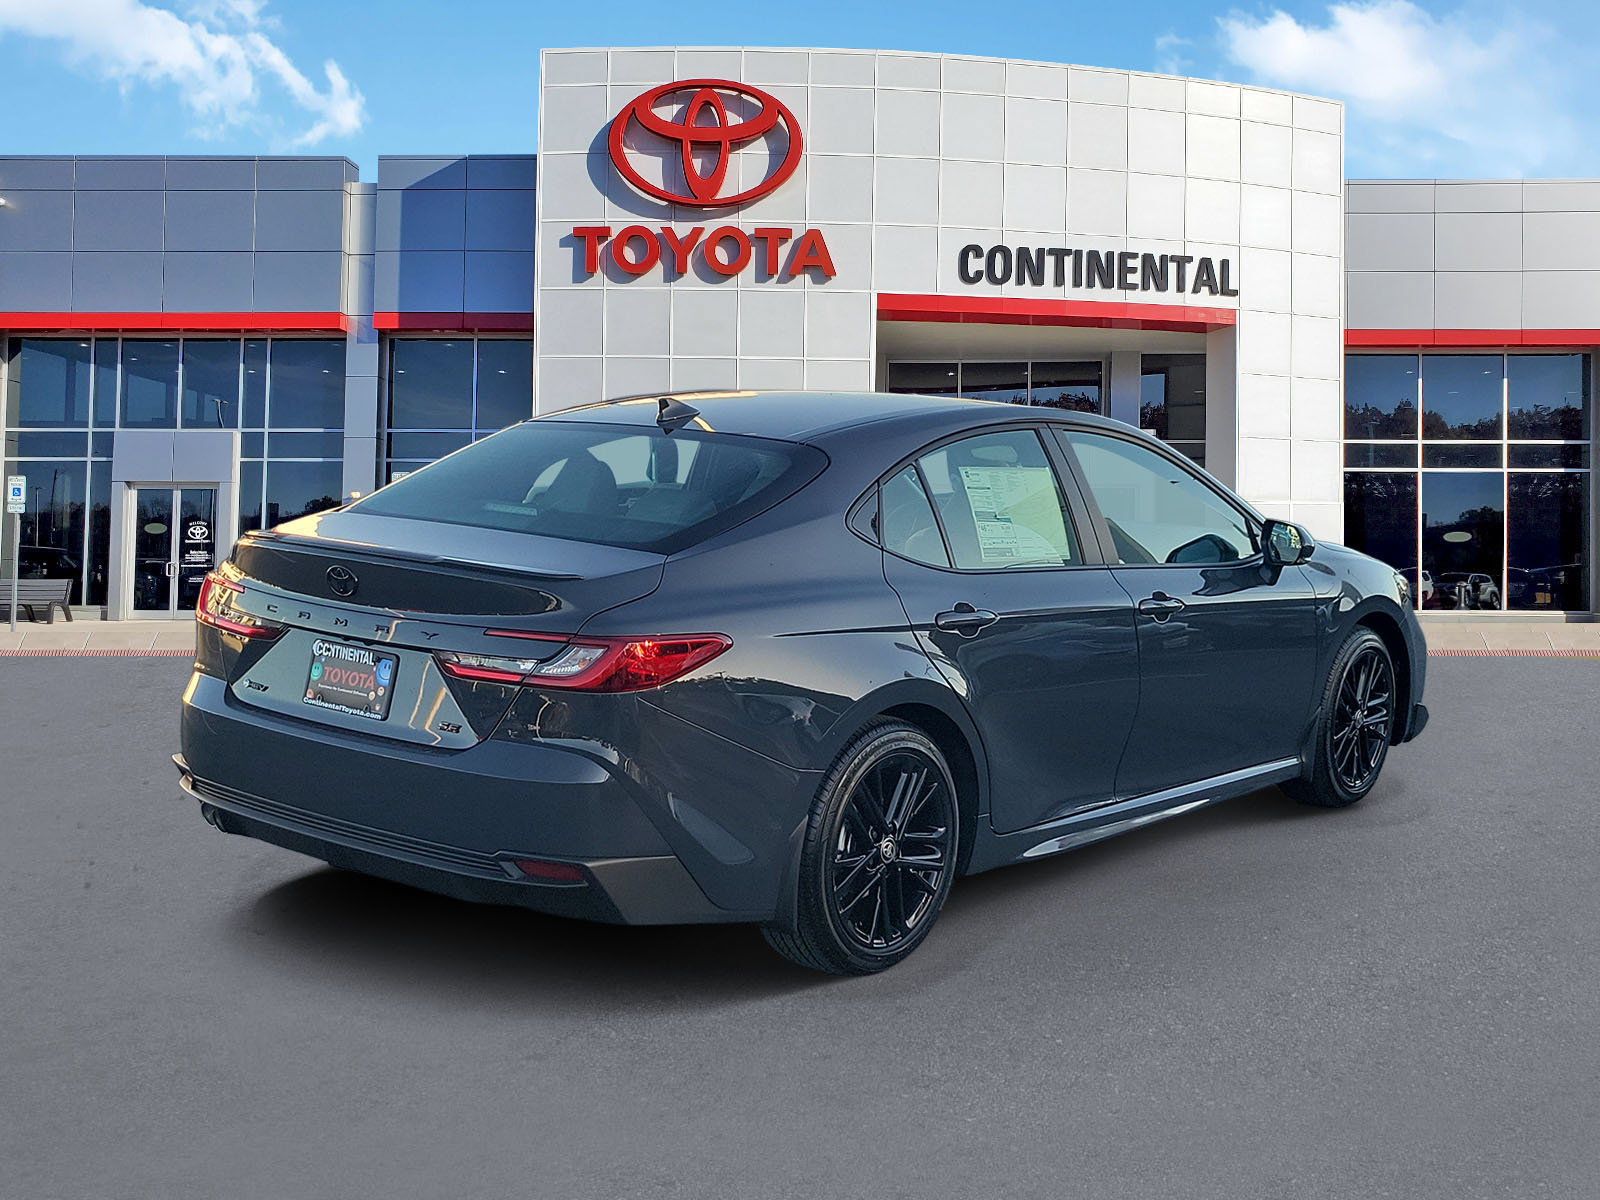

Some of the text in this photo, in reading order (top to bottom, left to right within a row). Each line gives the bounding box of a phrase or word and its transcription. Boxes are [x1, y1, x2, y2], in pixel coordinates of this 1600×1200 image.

[572, 225, 837, 278] TOYOTA
[958, 244, 1239, 297] CONTINENTAL
[267, 604, 439, 640] CAMRY
[324, 666, 374, 689] TOYOTA
[303, 697, 381, 720] ContinentalToyota.com
